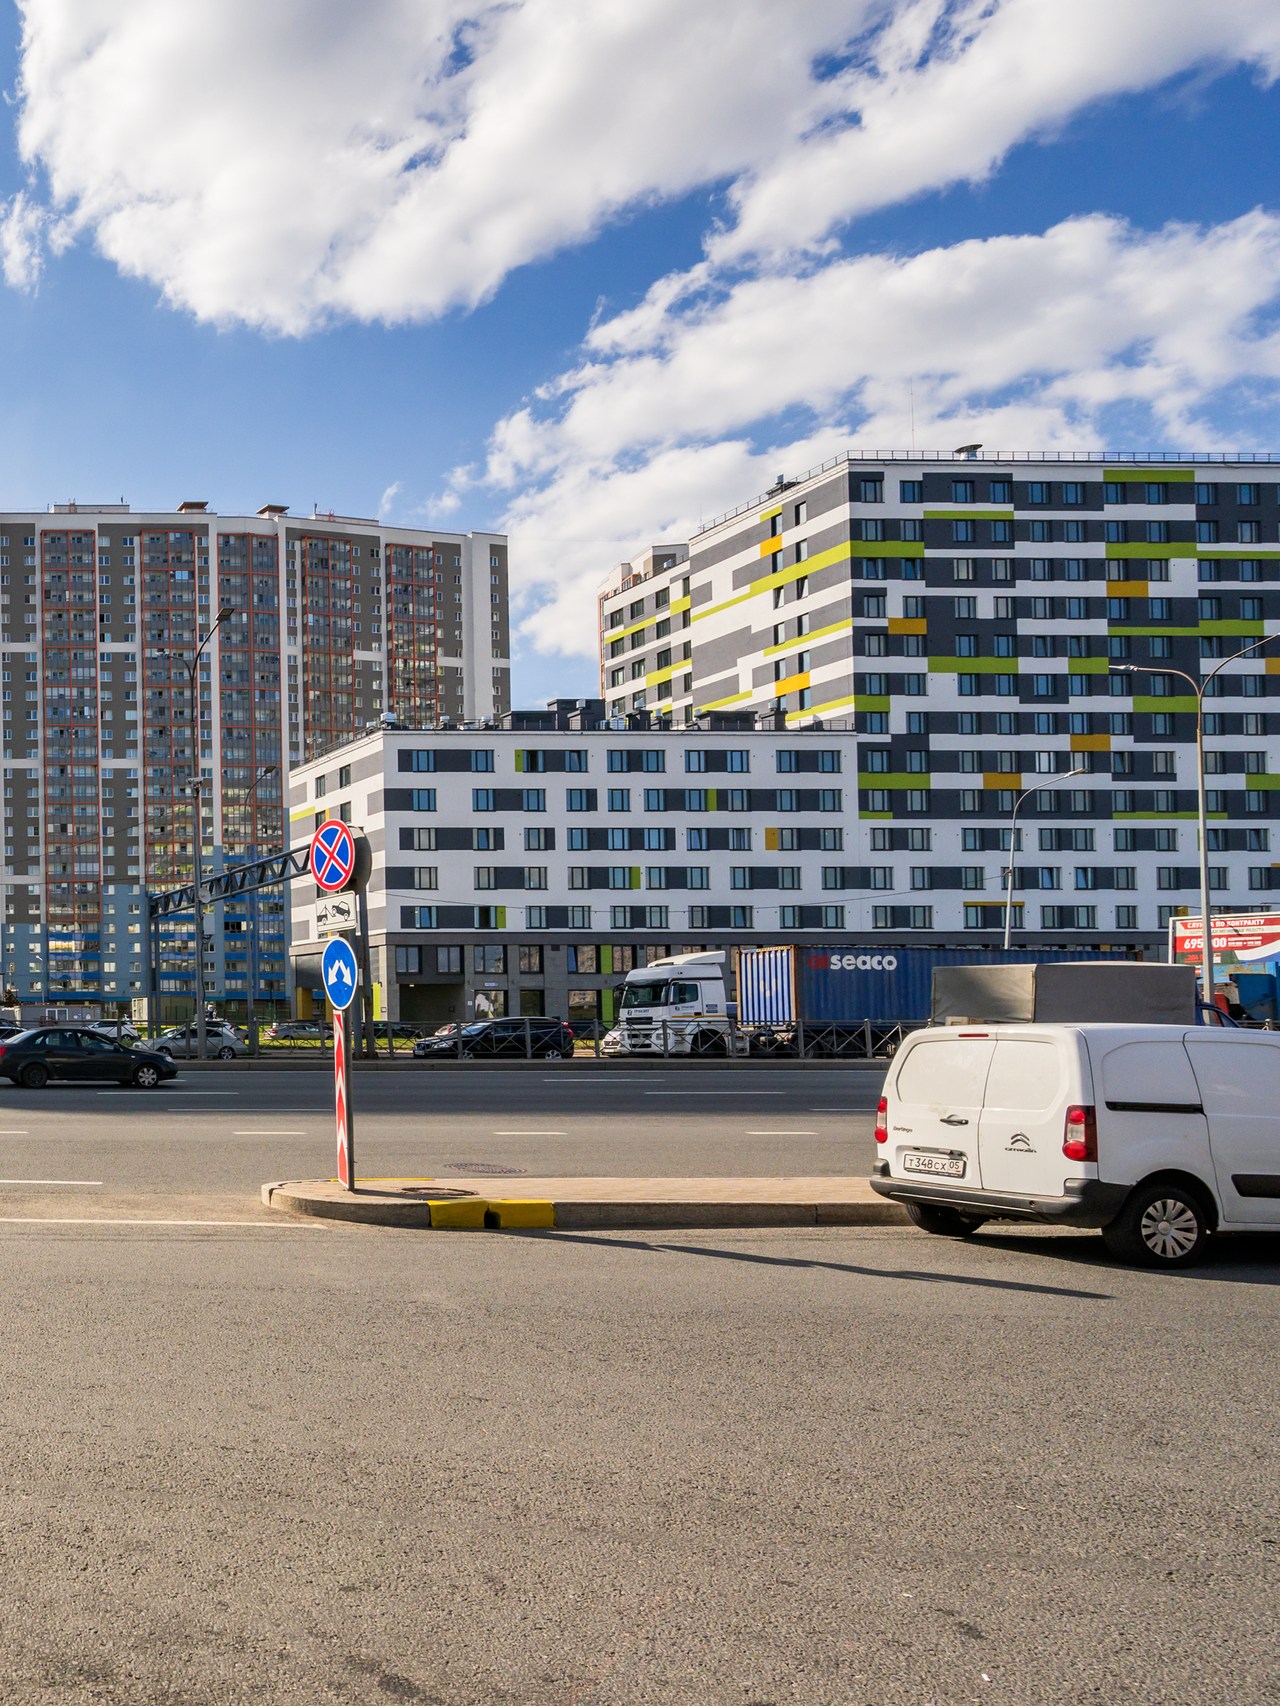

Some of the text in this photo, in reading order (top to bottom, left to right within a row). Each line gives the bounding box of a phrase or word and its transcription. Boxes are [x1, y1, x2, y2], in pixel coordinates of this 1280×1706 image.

[1226, 919, 1265, 927] КОНТРАКТУ
[1184, 938, 1203, 949] 695
[949, 1161, 960, 1170] 05
